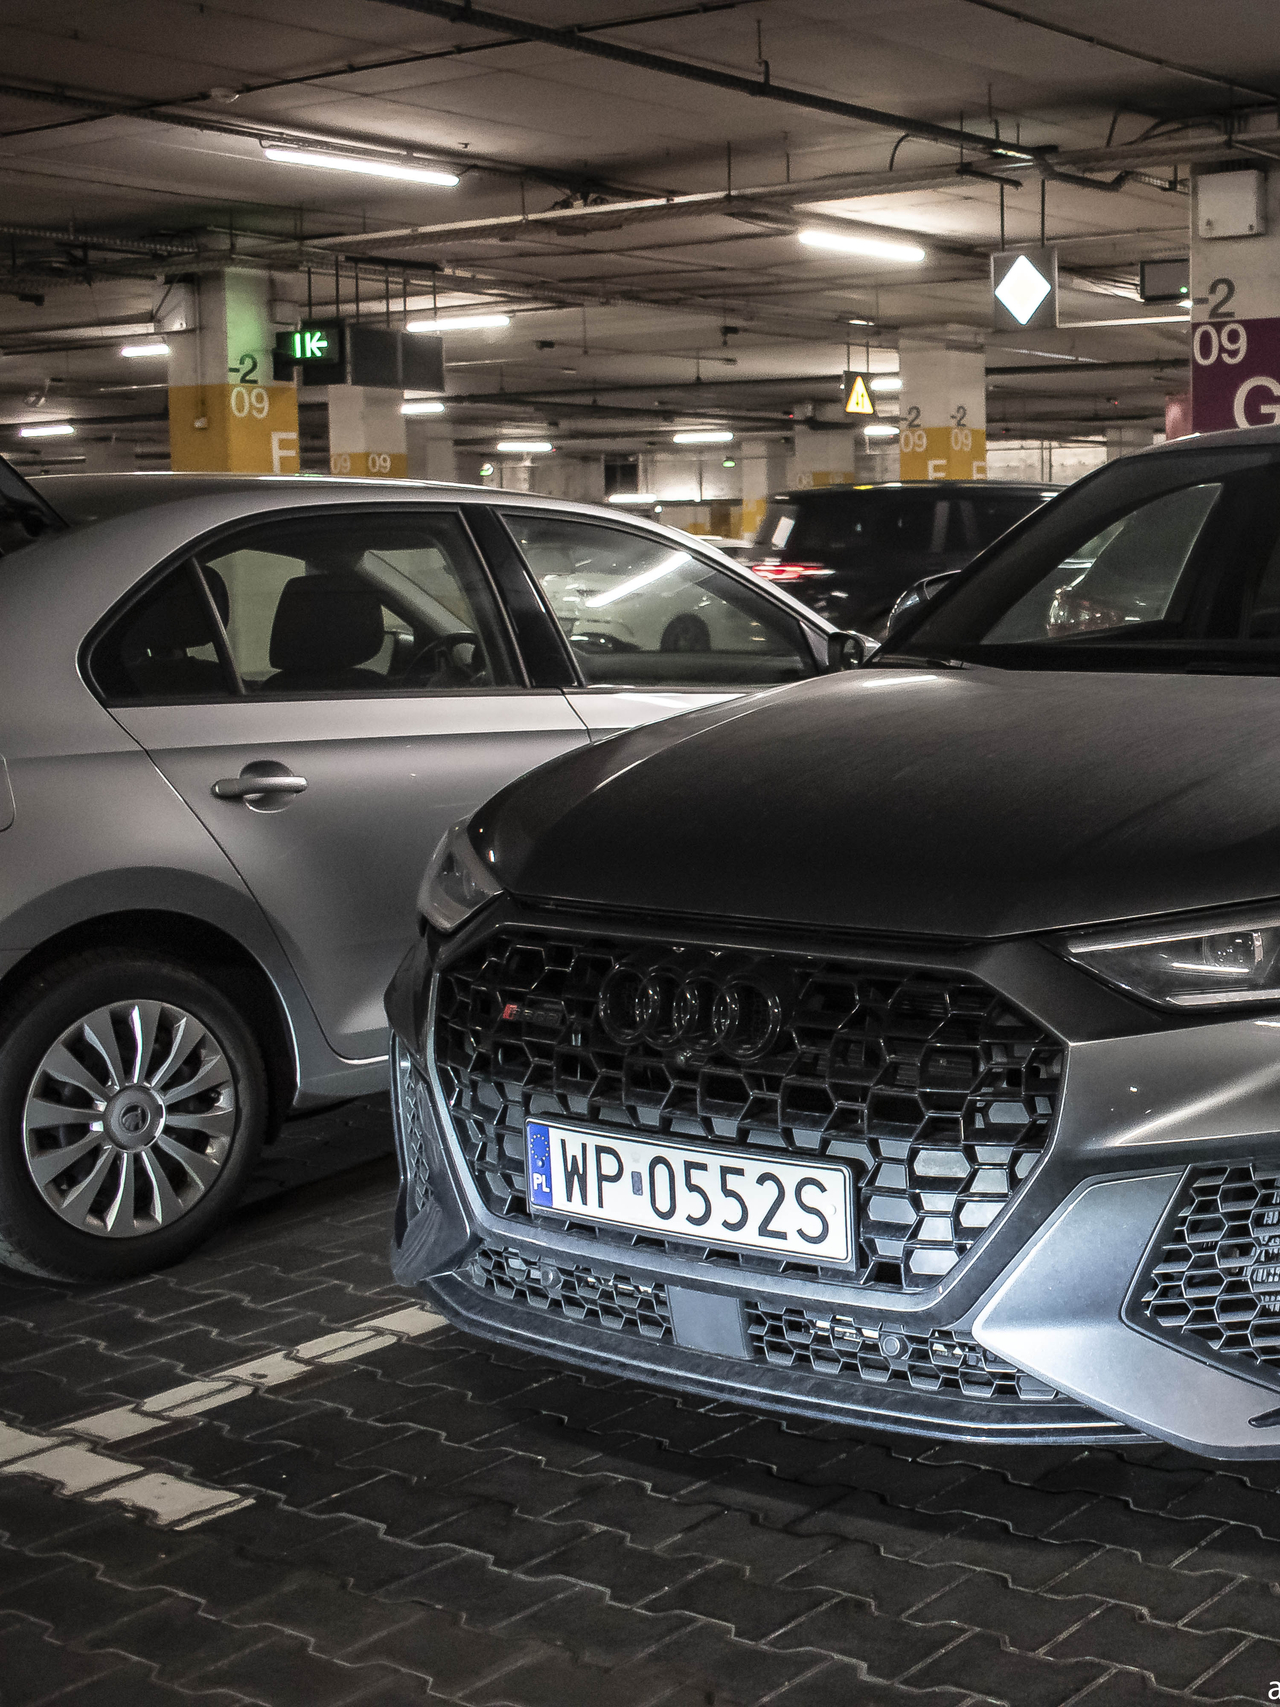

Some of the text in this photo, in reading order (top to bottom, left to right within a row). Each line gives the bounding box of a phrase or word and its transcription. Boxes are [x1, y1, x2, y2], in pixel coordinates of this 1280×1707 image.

[1192, 277, 1236, 320] -2
[1193, 322, 1248, 366] 09
[228, 353, 258, 385] -2
[231, 386, 270, 419] 09
[271, 431, 298, 474] F
[901, 430, 928, 452] 09
[951, 430, 973, 452] 09
[367, 454, 392, 473] 09
[533, 1173, 550, 1193] PL
[560, 1138, 830, 1246] WP 0552S
